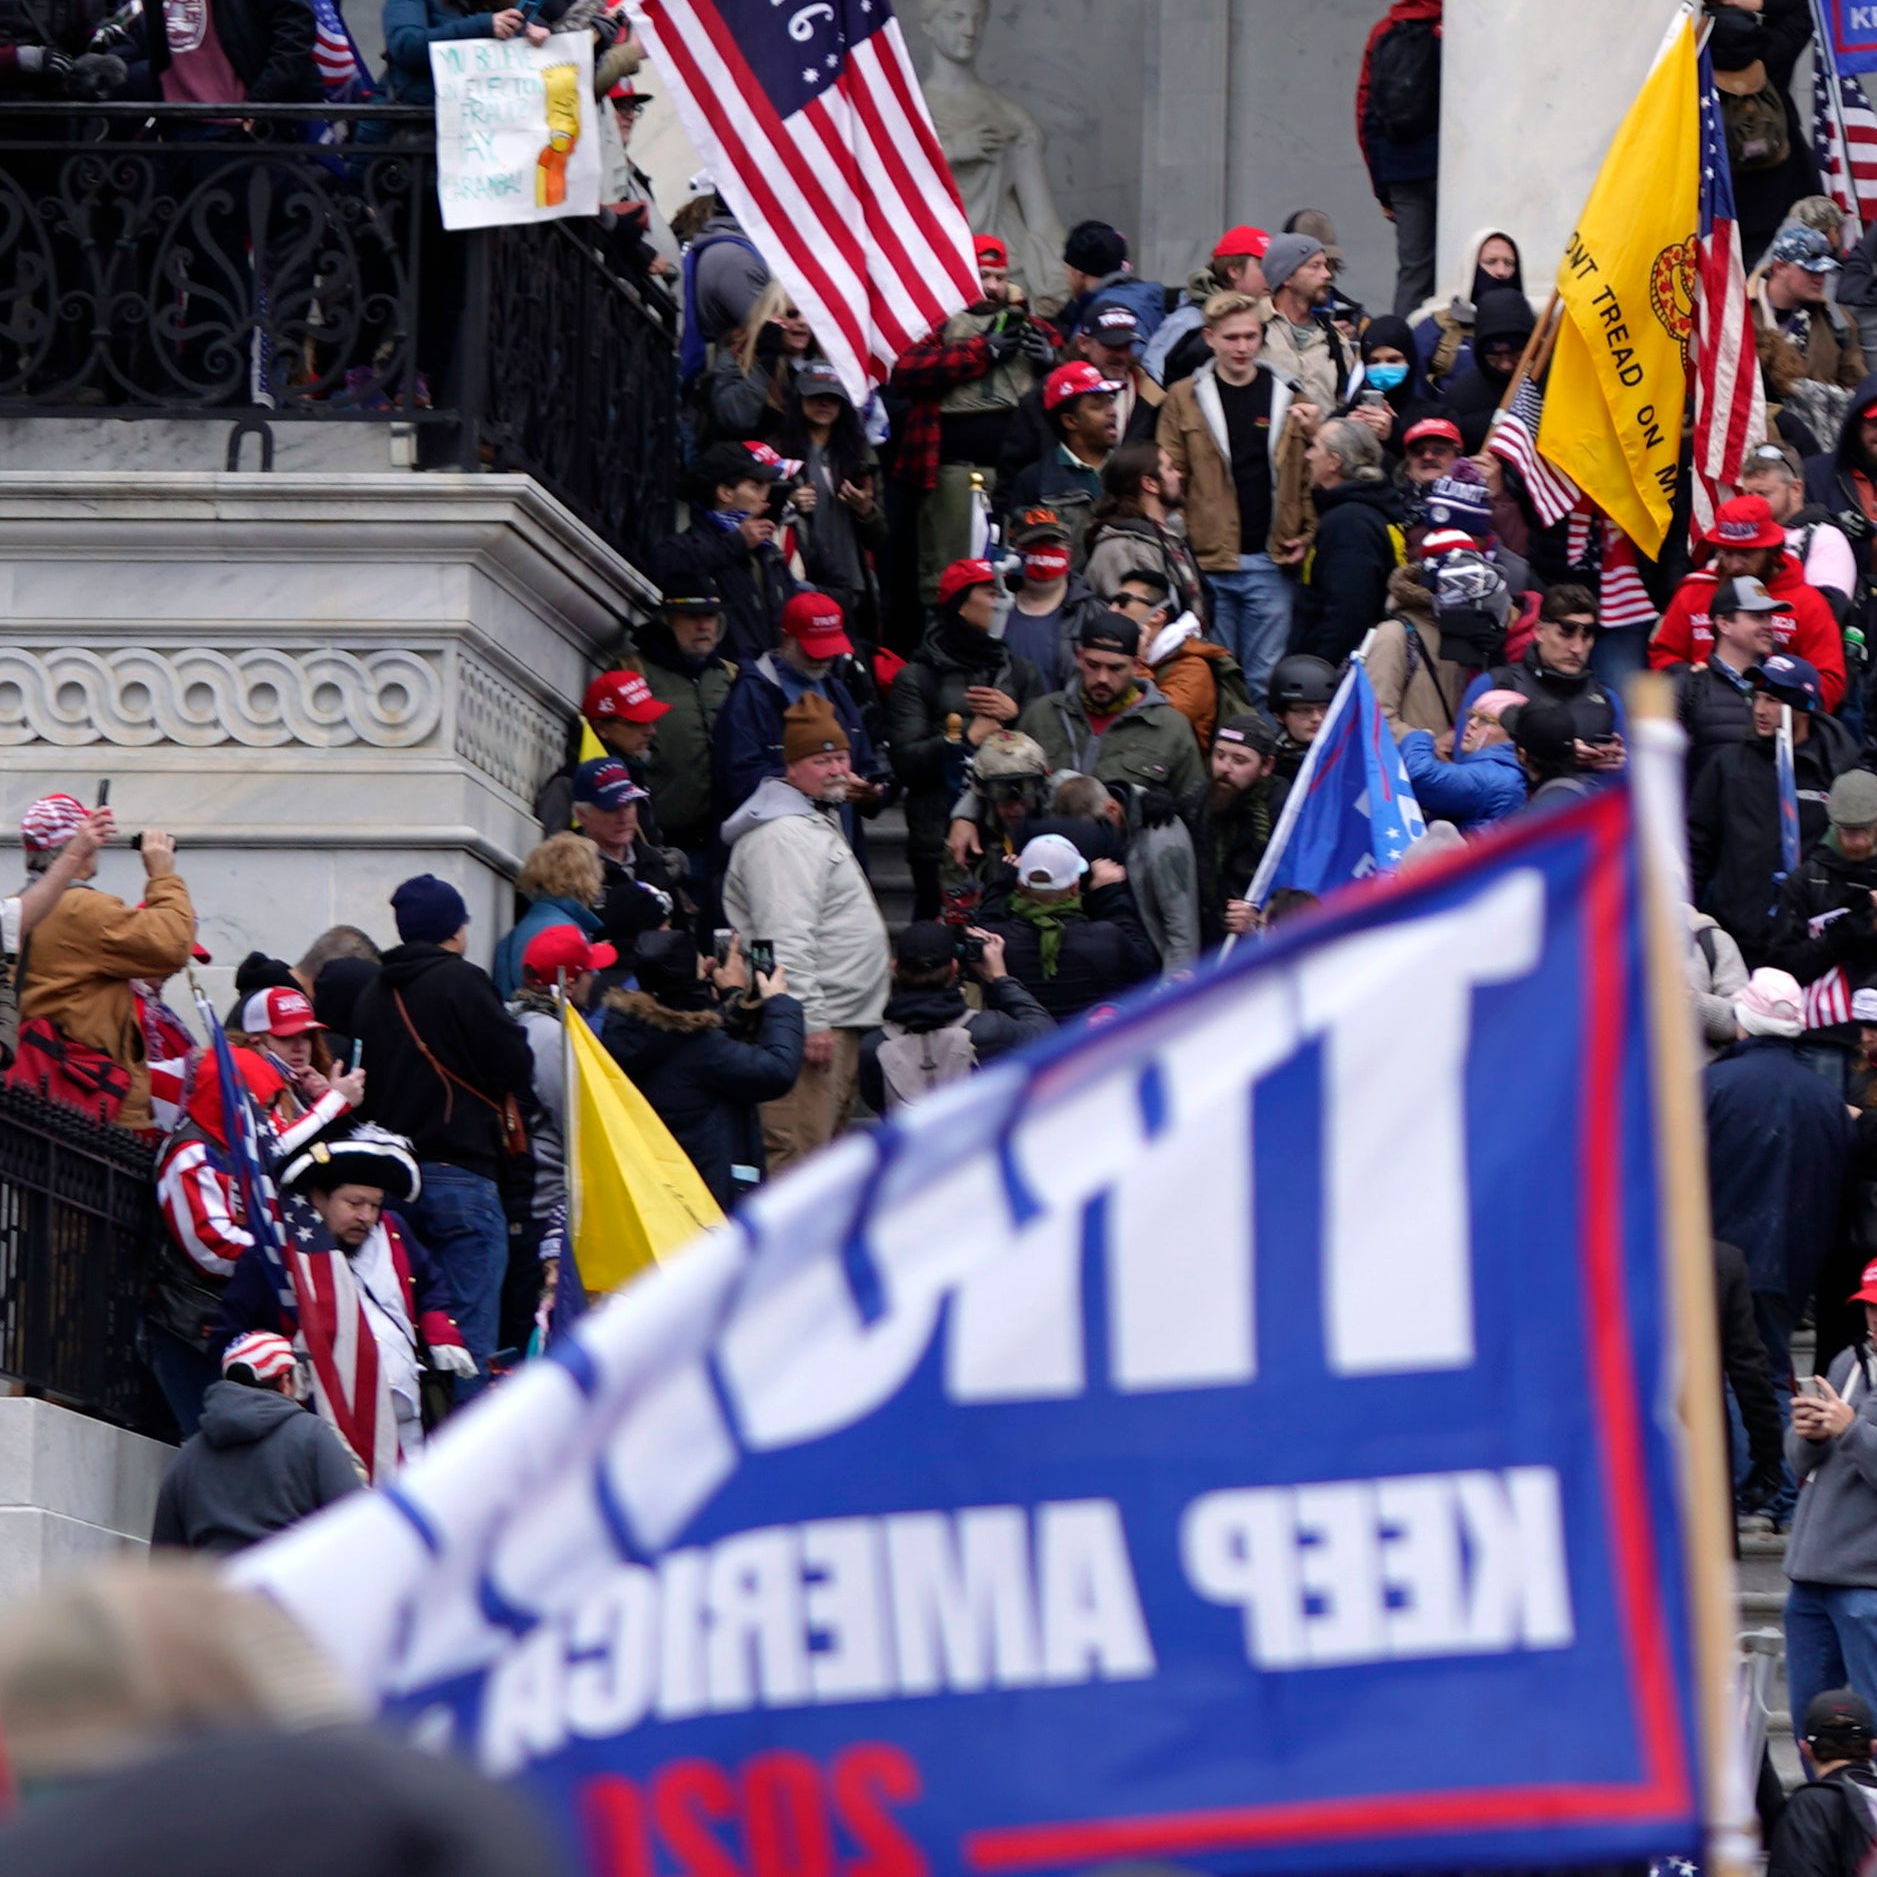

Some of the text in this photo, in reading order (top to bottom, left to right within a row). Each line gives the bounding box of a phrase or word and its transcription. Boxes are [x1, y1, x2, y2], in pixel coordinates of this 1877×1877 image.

[1564, 231, 1679, 512] ONT TREAD ON M
